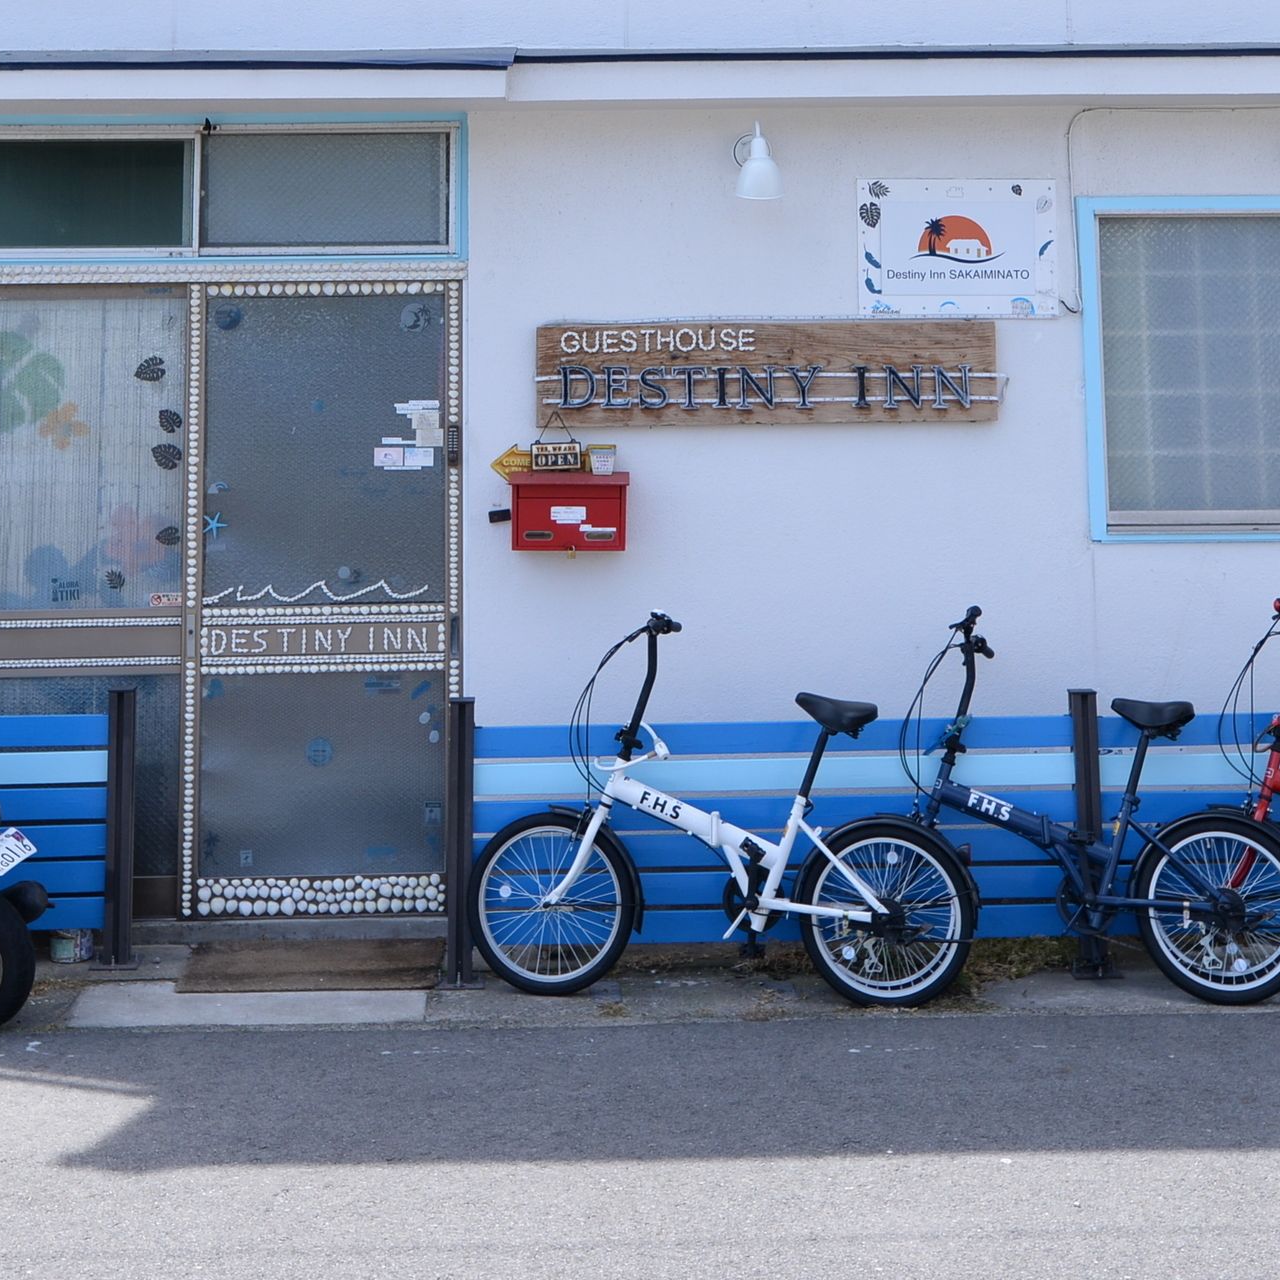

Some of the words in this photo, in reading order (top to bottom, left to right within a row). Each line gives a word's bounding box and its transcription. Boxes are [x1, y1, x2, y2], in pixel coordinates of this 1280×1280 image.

[886, 269, 926, 282] Destiny
[929, 269, 946, 280] Inn
[949, 269, 1030, 280] SAKAIMINATO
[560, 328, 756, 353] GUESTHOUSE
[558, 365, 824, 410] DESTINY
[851, 364, 972, 409] INN
[503, 458, 531, 466] COME
[538, 454, 576, 467] OPEN
[59, 589, 80, 601] TIKI
[211, 626, 353, 656] DESTINY
[369, 626, 428, 653] INN
[639, 790, 682, 821] F.H.S
[967, 793, 1012, 822] F.H.S
